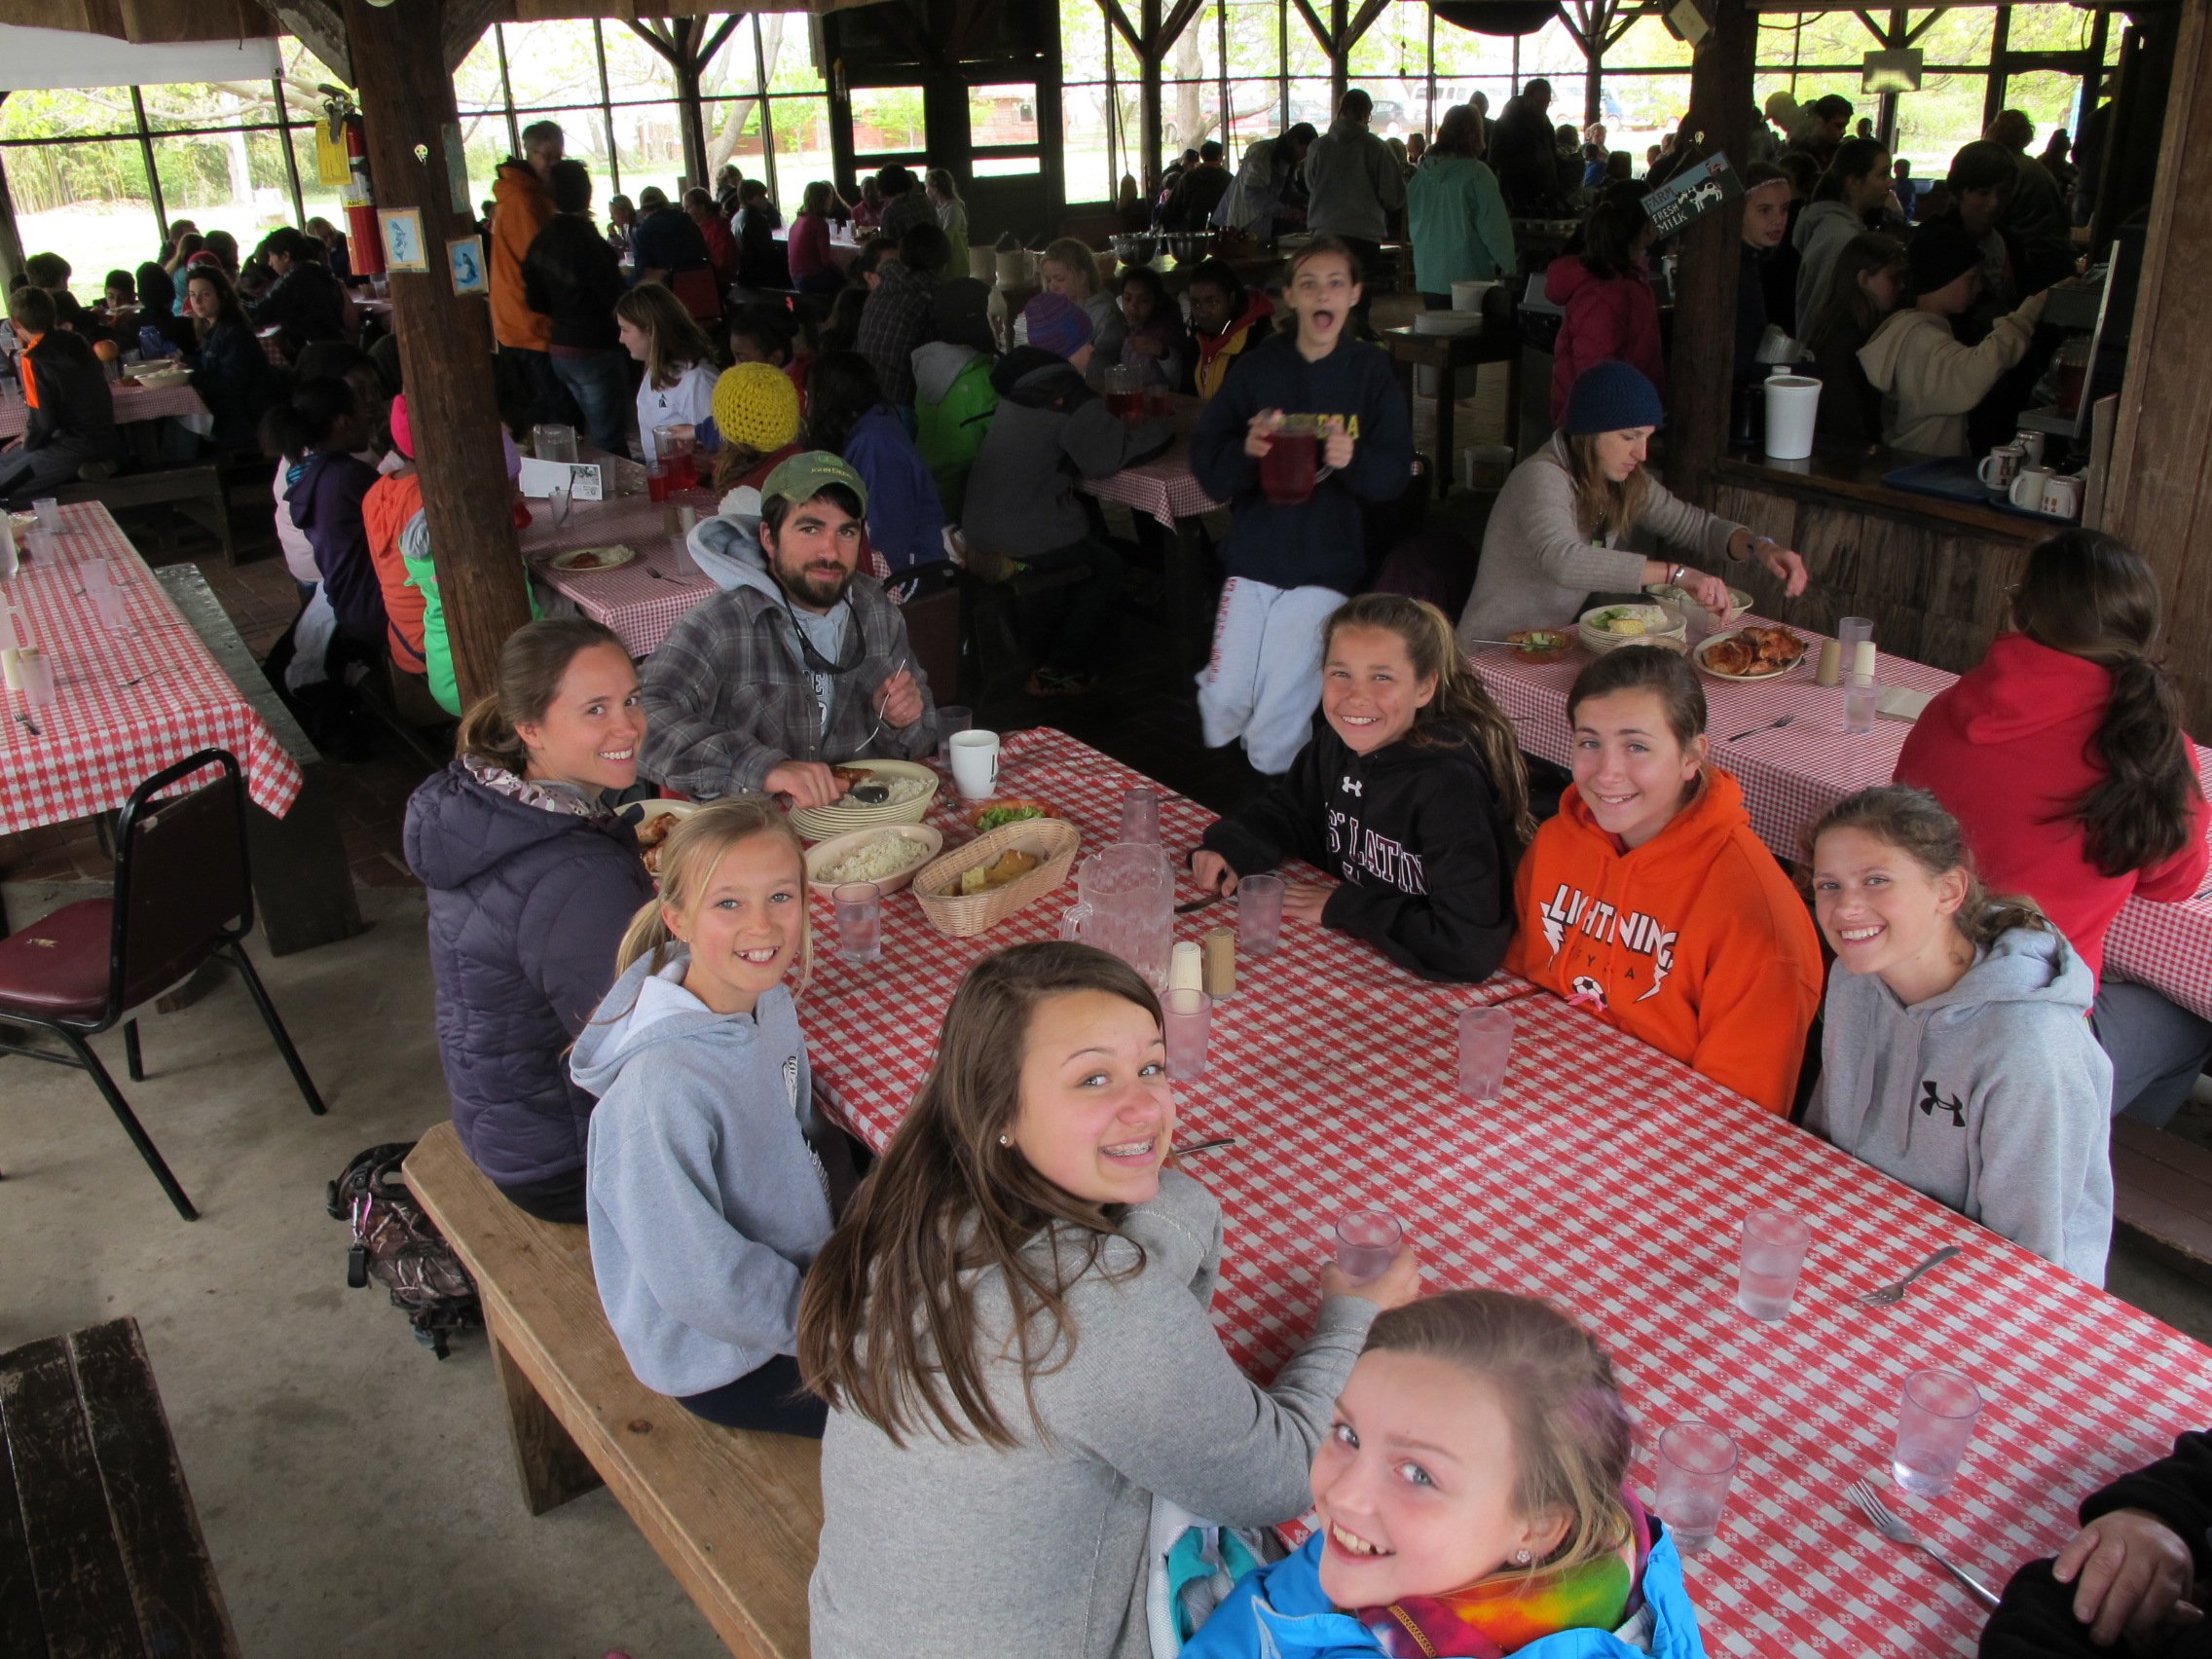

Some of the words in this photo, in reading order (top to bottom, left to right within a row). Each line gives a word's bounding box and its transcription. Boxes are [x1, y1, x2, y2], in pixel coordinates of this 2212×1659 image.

[1643, 185, 1676, 211] FARM
[1652, 202, 1680, 224] FRESH
[1657, 212, 1688, 234] MILK
[1349, 817, 1430, 896] LATIN
